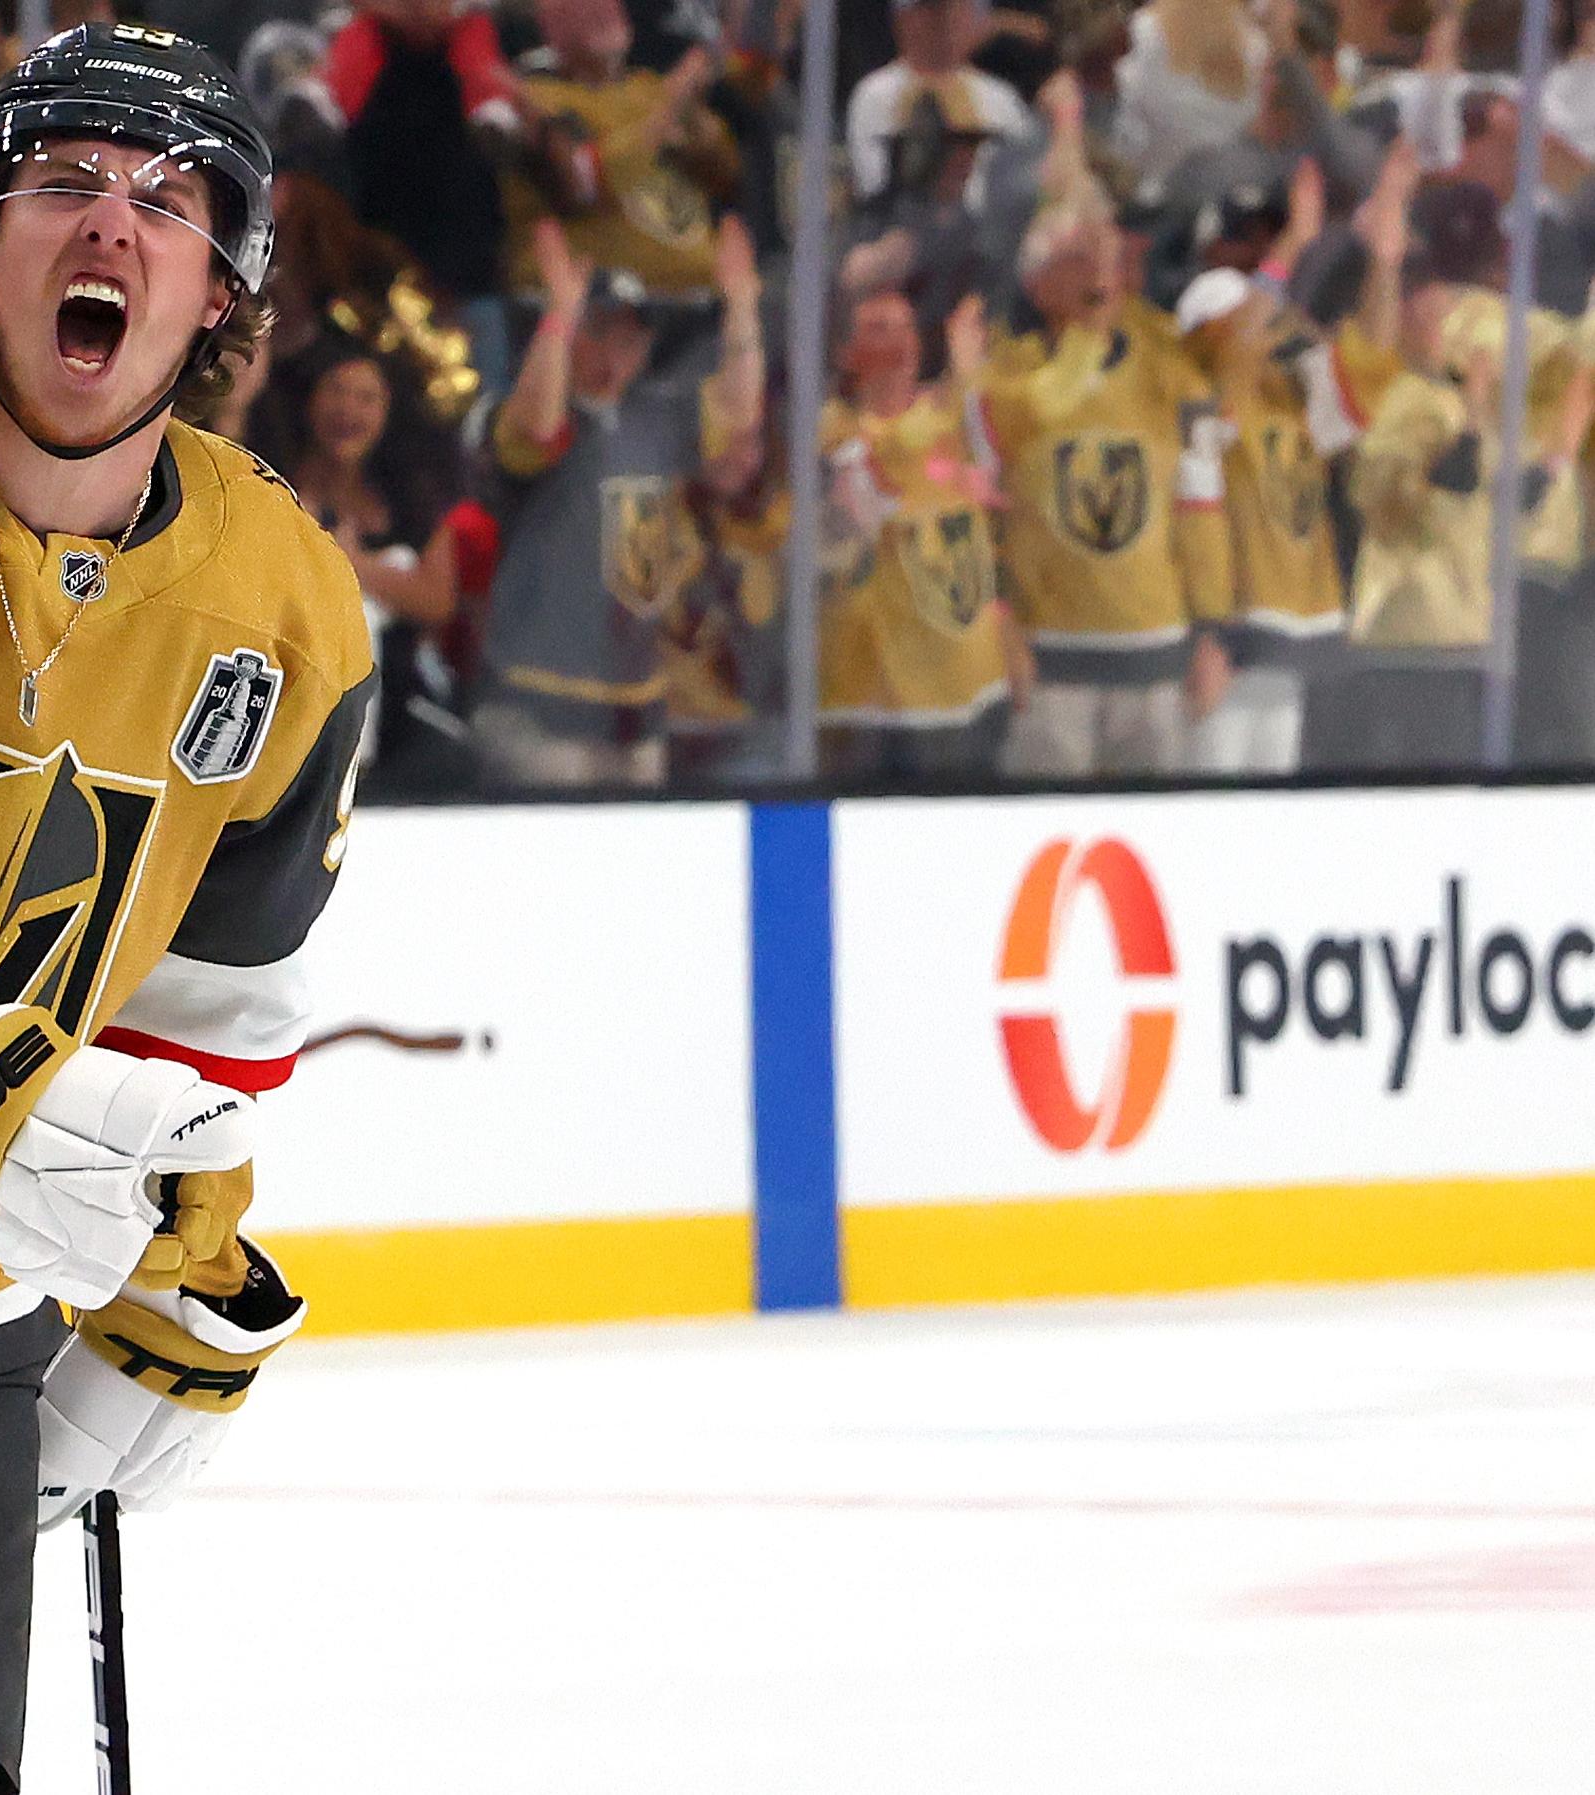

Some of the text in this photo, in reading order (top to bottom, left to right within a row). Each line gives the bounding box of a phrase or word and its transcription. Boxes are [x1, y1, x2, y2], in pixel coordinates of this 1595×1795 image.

[85, 58, 182, 84] WARRIOR
[70, 564, 96, 590] NHL
[211, 685, 226, 698] 20
[250, 695, 265, 708] 26
[1226, 874, 1595, 1098] payloc
[170, 1101, 238, 1141] TRUE
